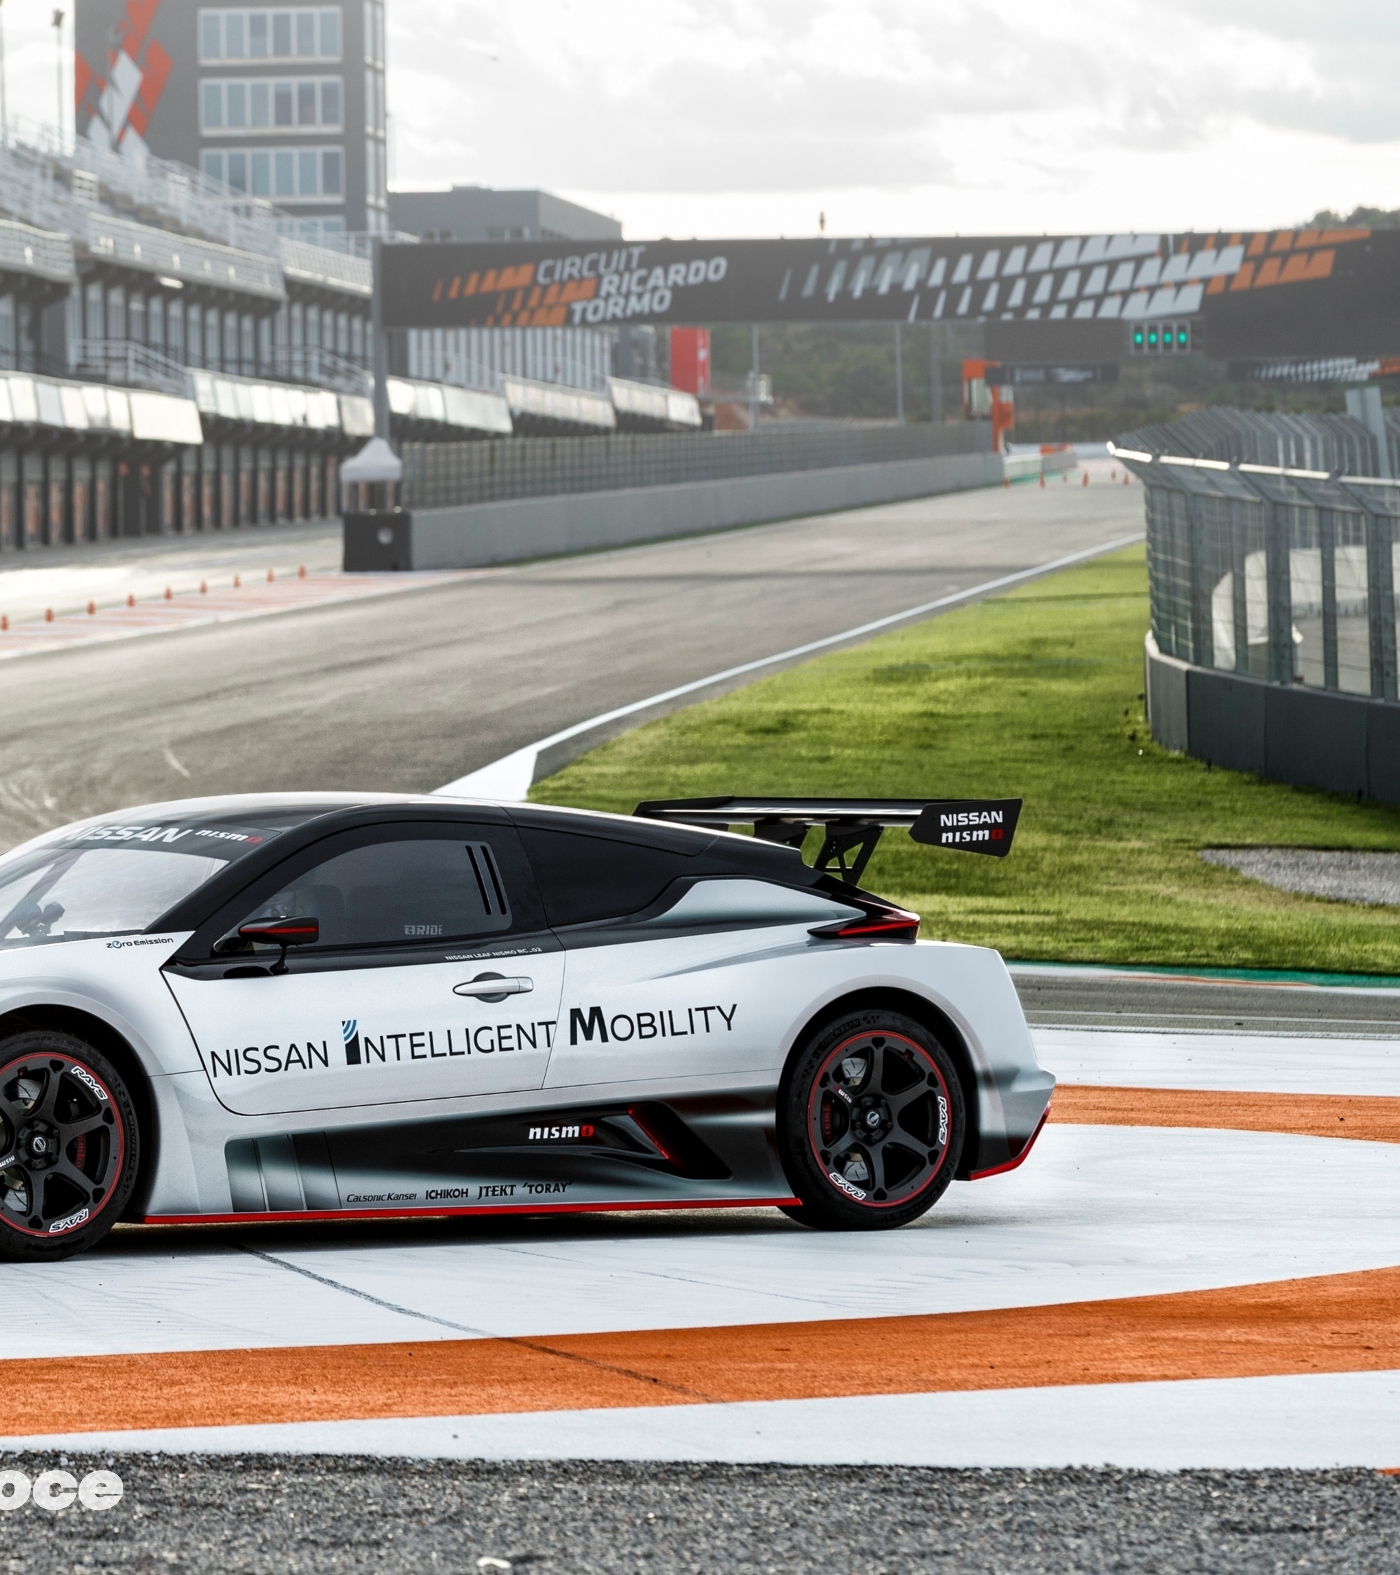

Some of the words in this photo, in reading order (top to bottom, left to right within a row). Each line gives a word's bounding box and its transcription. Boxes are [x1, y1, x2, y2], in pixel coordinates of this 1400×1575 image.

[536, 245, 646, 285] CIRCUIT
[600, 256, 728, 298] RICARDO
[570, 289, 672, 325] TORMO
[940, 810, 1003, 827] NISSAN
[58, 825, 192, 843] NISSAN
[941, 829, 1004, 843] nismo
[404, 924, 443, 936] BRIDE
[211, 1040, 329, 1078] NISSAN
[342, 1019, 557, 1066] INTELLIGENT
[569, 1004, 737, 1046] MOBILITY
[71, 1066, 108, 1100] RAYS
[526, 1124, 594, 1139] nismo
[937, 1096, 947, 1145] RAYS
[425, 1188, 469, 1200] ICHIKOH
[477, 1184, 516, 1200] JTEKT
[829, 1172, 866, 1200] RAYS
[49, 1208, 89, 1233] RAYS
